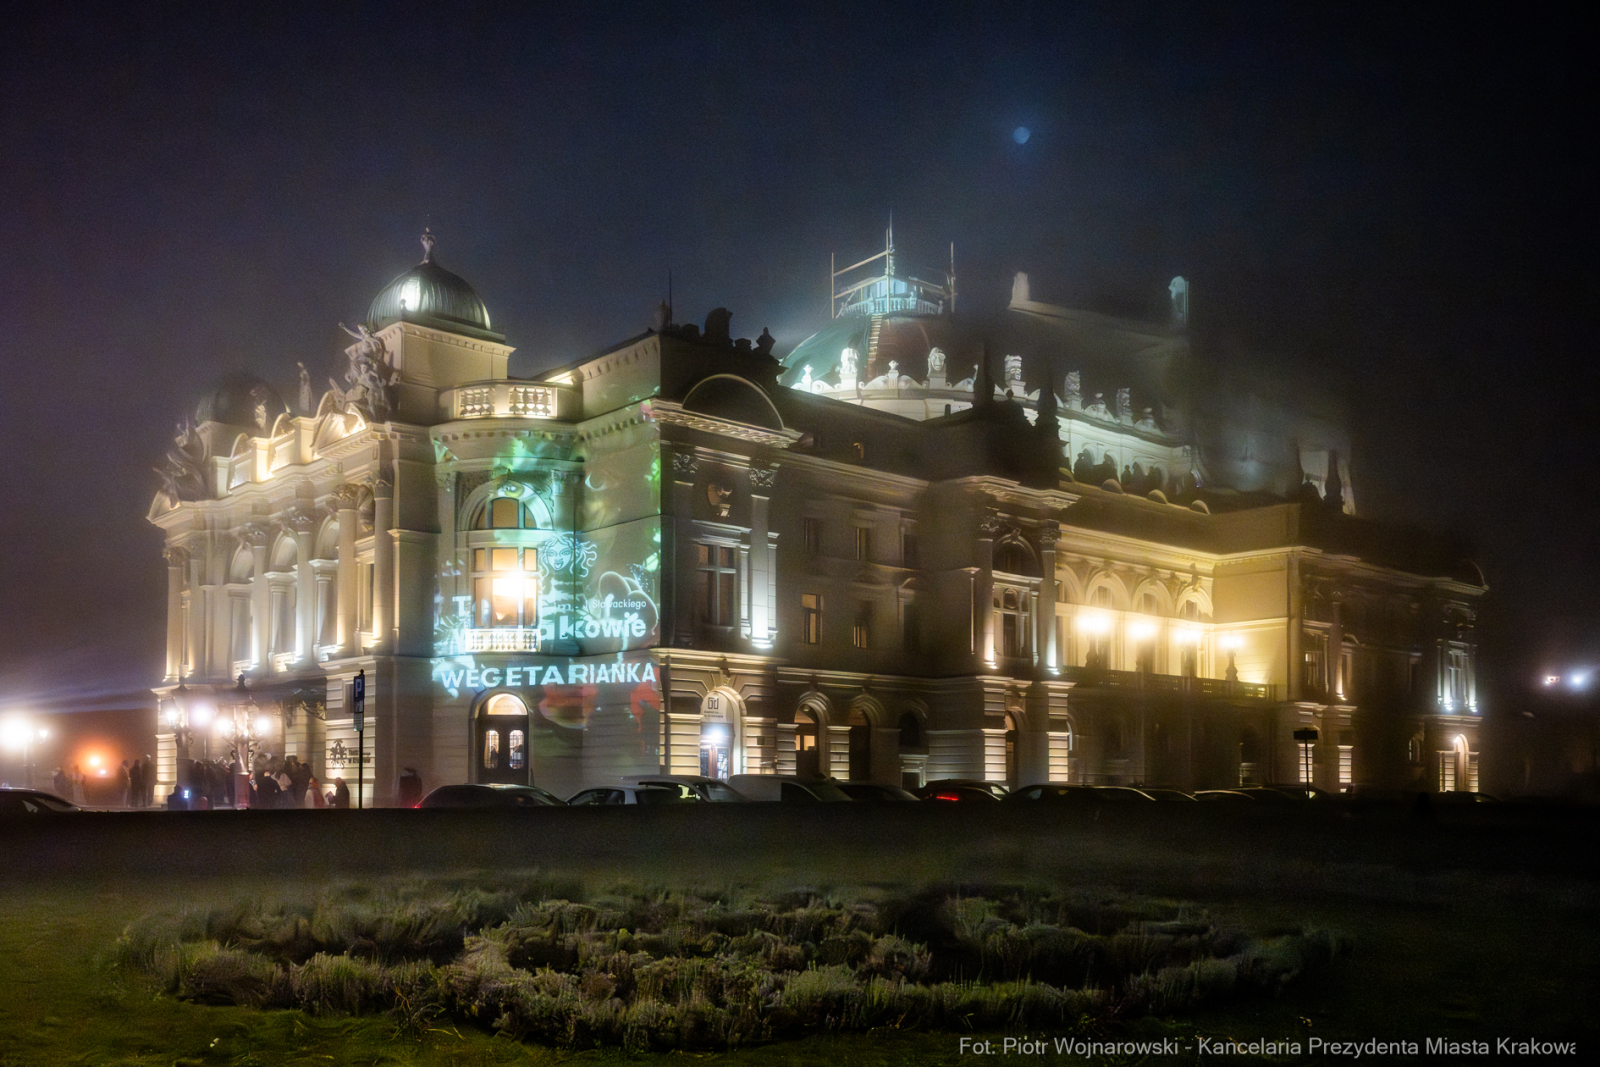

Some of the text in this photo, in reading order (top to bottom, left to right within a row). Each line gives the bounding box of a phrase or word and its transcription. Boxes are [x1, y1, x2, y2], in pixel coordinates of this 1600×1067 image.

[593, 598, 646, 611] Słoackiego
[440, 662, 657, 688] WEGETARIANKA
[355, 678, 362, 698] P
